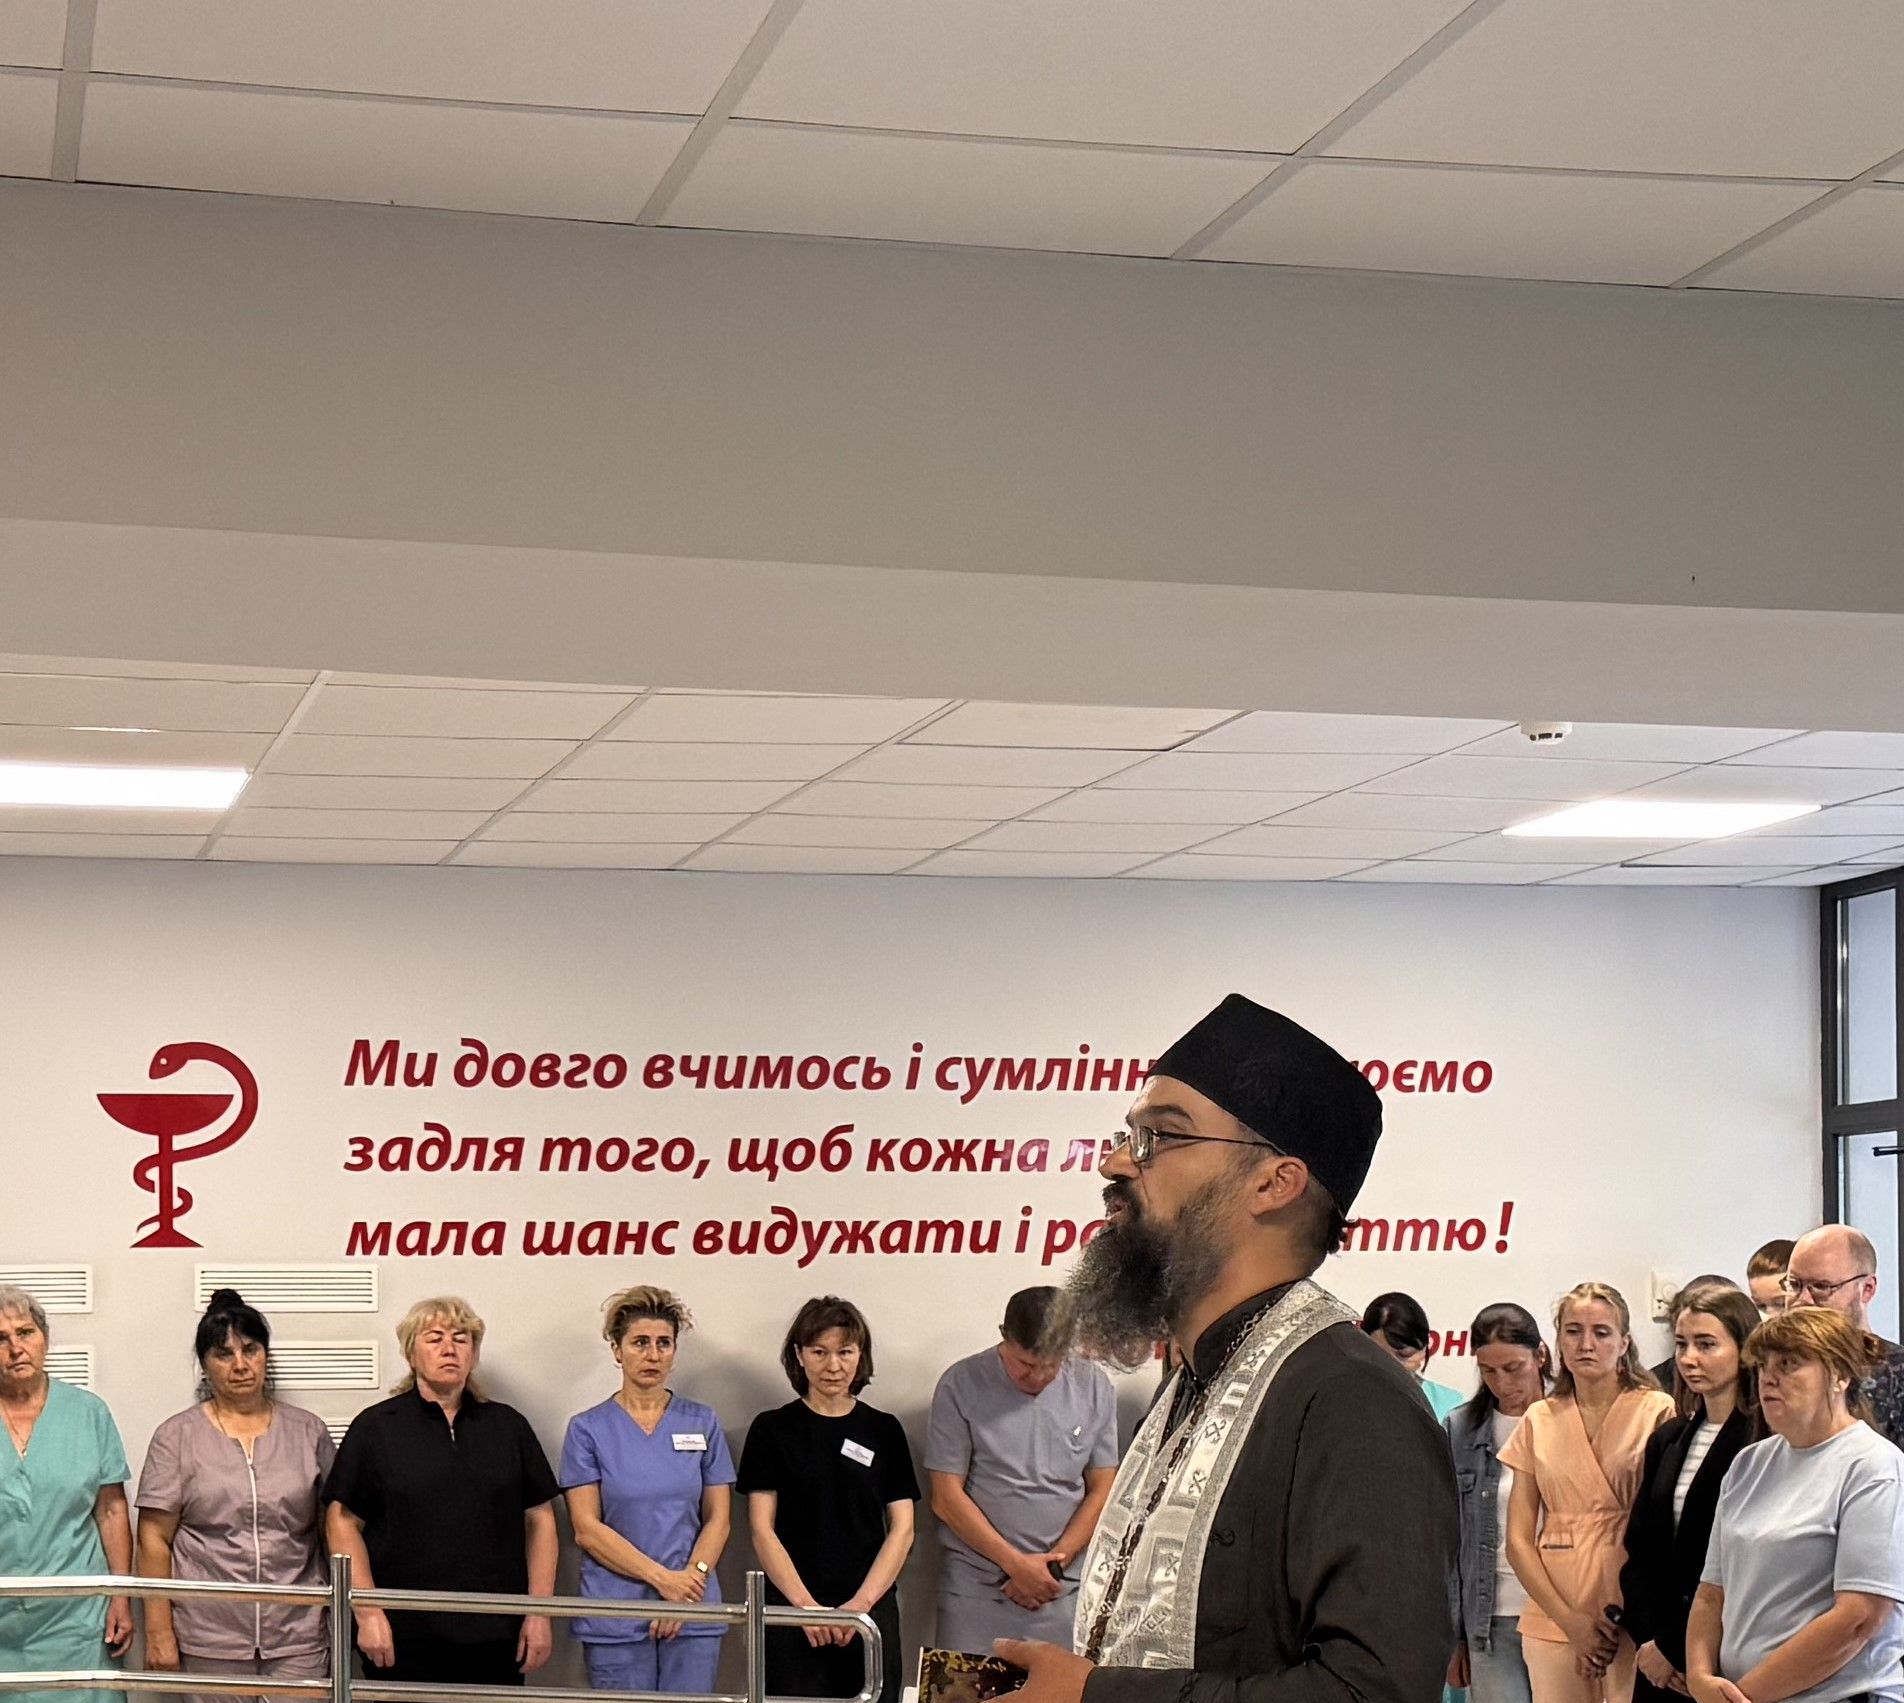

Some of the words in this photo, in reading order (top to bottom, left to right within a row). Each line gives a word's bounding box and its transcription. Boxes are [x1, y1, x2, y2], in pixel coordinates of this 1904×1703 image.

[344, 1039, 438, 1088] Ми
[453, 1038, 628, 1090] довго
[642, 1054, 892, 1091] вчимось
[906, 1042, 924, 1090] і
[935, 1043, 1156, 1105] сумлінн
[344, 1121, 526, 1173] задля
[539, 1136, 711, 1179] того,
[727, 1124, 855, 1182] щоб
[867, 1137, 1050, 1174] кожна
[346, 1220, 508, 1257] мала
[522, 1219, 680, 1257] шанс
[692, 1206, 1002, 1269] видужати
[1014, 1206, 1034, 1254] і
